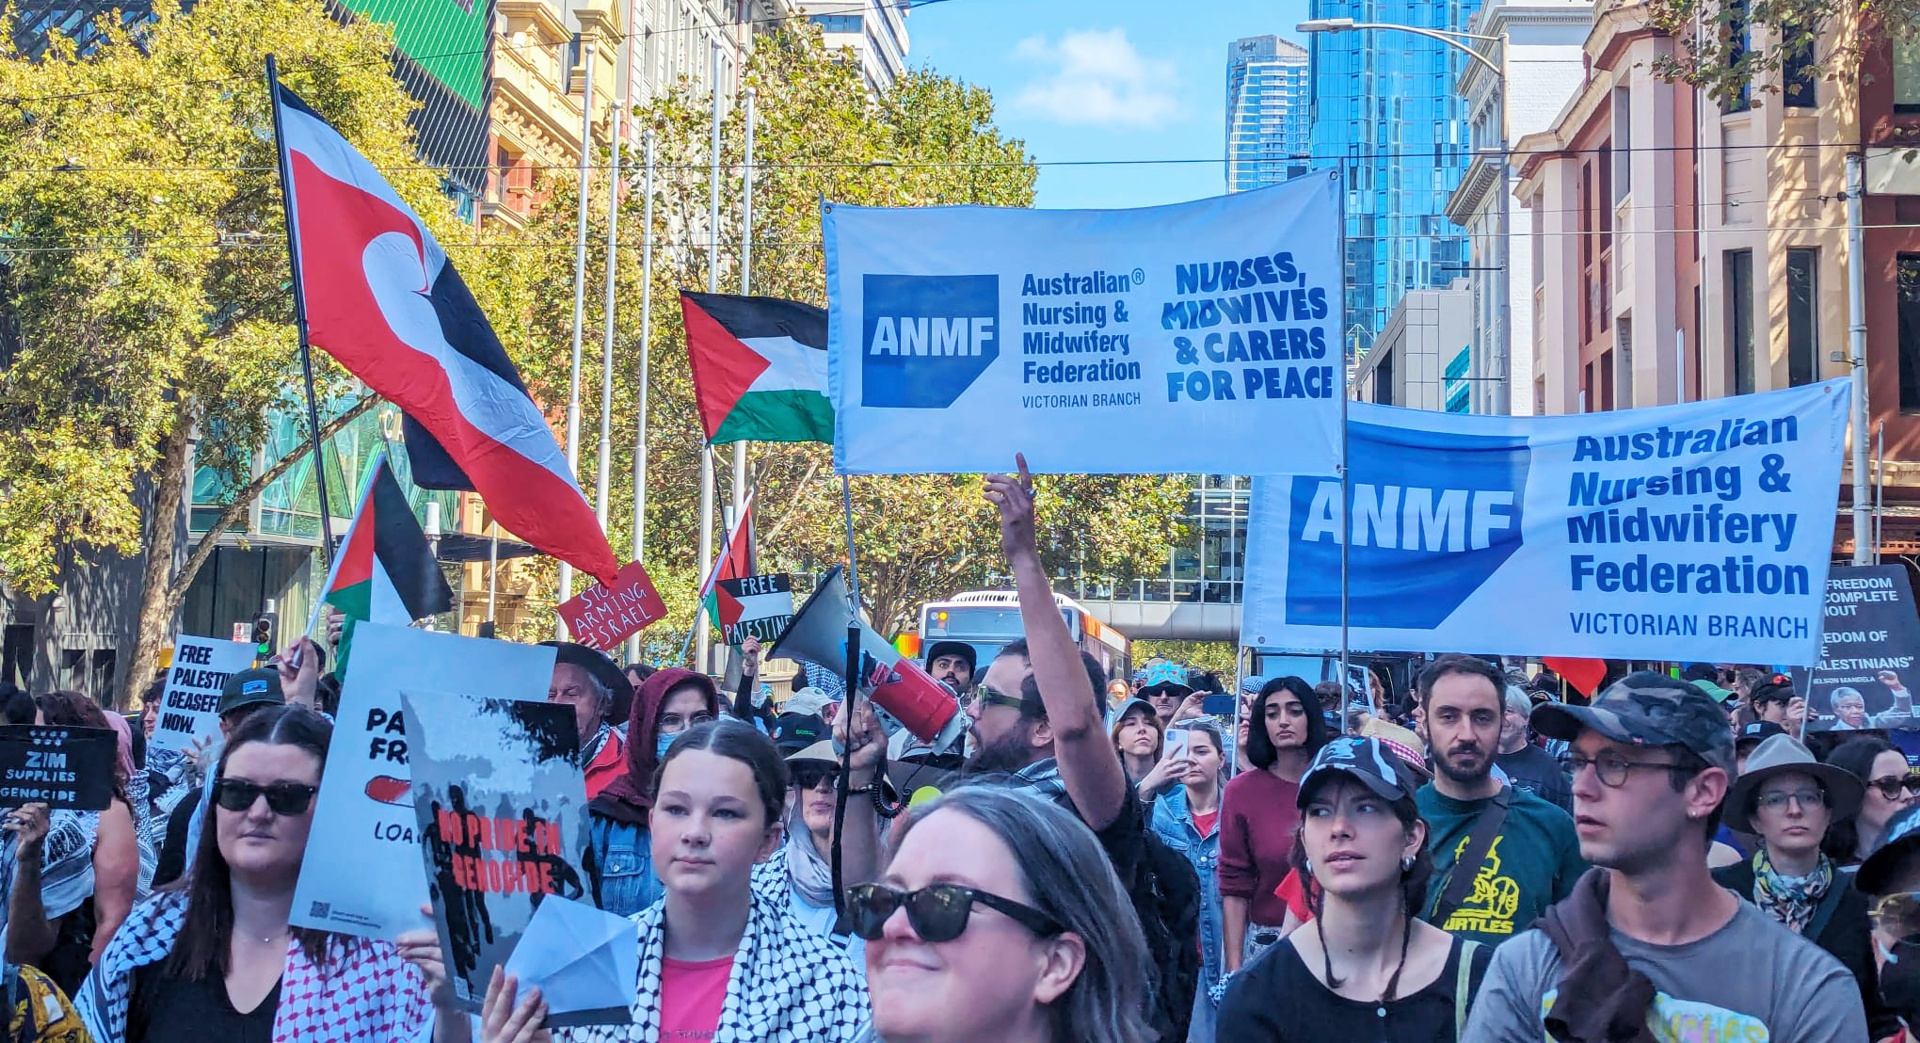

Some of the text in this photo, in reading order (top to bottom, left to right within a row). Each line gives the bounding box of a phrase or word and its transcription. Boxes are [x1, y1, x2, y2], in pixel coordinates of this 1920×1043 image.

[1175, 251, 1306, 295] NURSES,
[1022, 299, 1129, 329] Nursing &
[1160, 287, 1328, 331] MIDWIVES
[869, 316, 994, 357] ANMF
[1023, 330, 1130, 356] Midwifery
[1174, 326, 1326, 366] & CARERS
[1023, 357, 1141, 384] Federation
[1166, 365, 1334, 403] FOR PEACE
[1022, 391, 1141, 408] VICTORIAN BRANCH
[1572, 415, 1798, 463] Australian
[1568, 453, 1792, 508] Nursing &
[1300, 481, 1515, 553] ANMF
[1568, 505, 1798, 552] Midwifery
[740, 574, 778, 596] FREE
[1571, 554, 1809, 596] Federation
[575, 582, 647, 636] ARMING
[580, 583, 609, 610] STO
[588, 603, 652, 645] ISRAEL
[1570, 612, 1809, 639] VICTORIAN BRANCH
[1869, 630, 1888, 642] OF
[178, 644, 213, 665] FREE
[1803, 656, 1914, 671] ALESTINIANS"
[167, 690, 221, 713] CEASEFI
[161, 712, 195, 735] NOW.
[25, 751, 67, 769] ZIM
[369, 737, 410, 765] FR
[5, 769, 76, 782] SUPPLIES
[0, 787, 76, 802] GENOCIDE
[374, 821, 421, 844] LOA
[437, 809, 561, 856] NO PRIDE IN
[452, 852, 555, 895] GENOCIDE
[1442, 917, 1514, 934] URTLES
